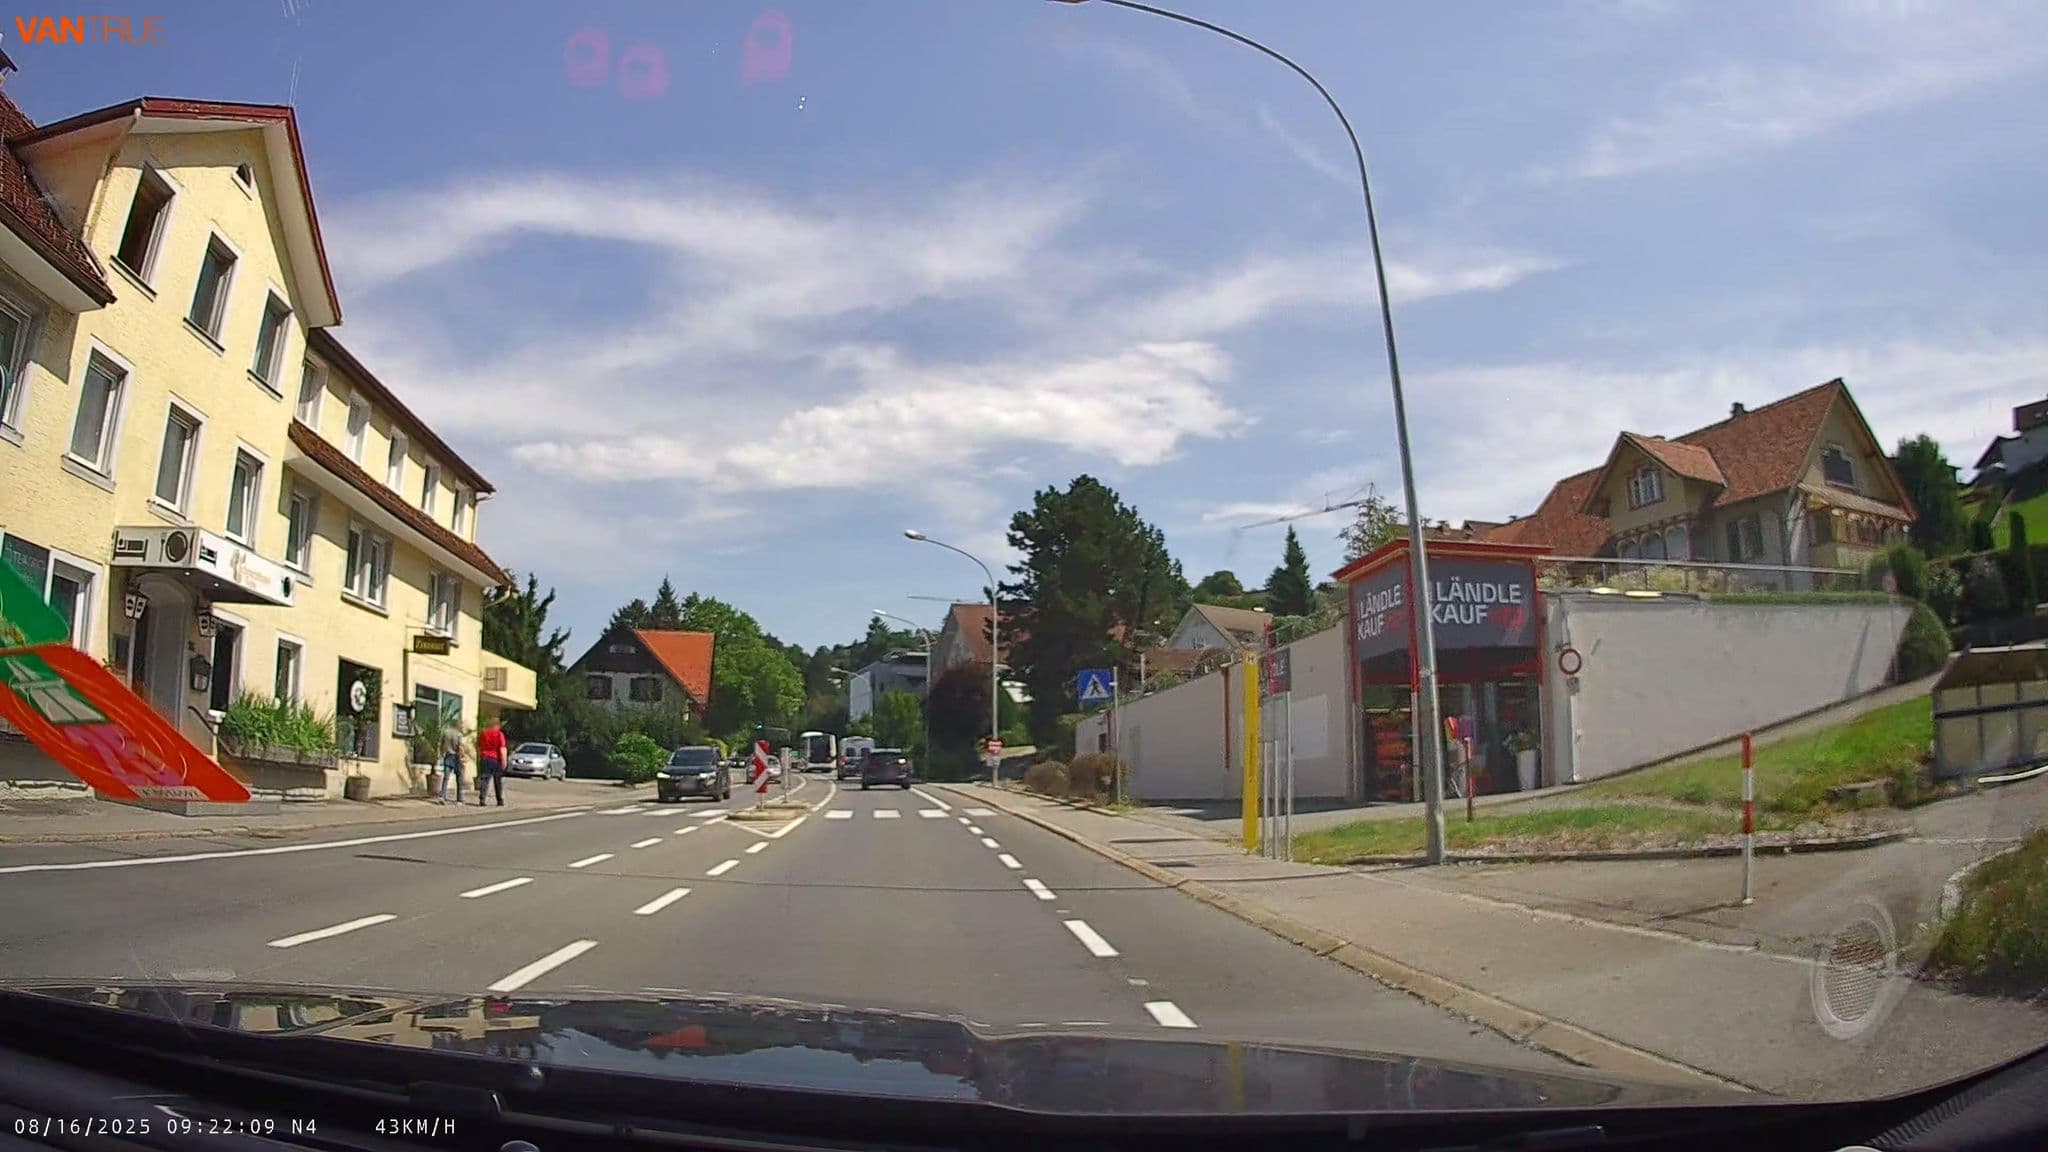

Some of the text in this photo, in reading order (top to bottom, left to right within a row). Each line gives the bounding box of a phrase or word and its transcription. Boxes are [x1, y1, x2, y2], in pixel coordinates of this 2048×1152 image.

[1360, 584, 1403, 618] LÄNDLE
[1436, 576, 1522, 605] LÄNDLE
[1357, 614, 1385, 641] KAUF
[1430, 603, 1489, 625] KAUF
